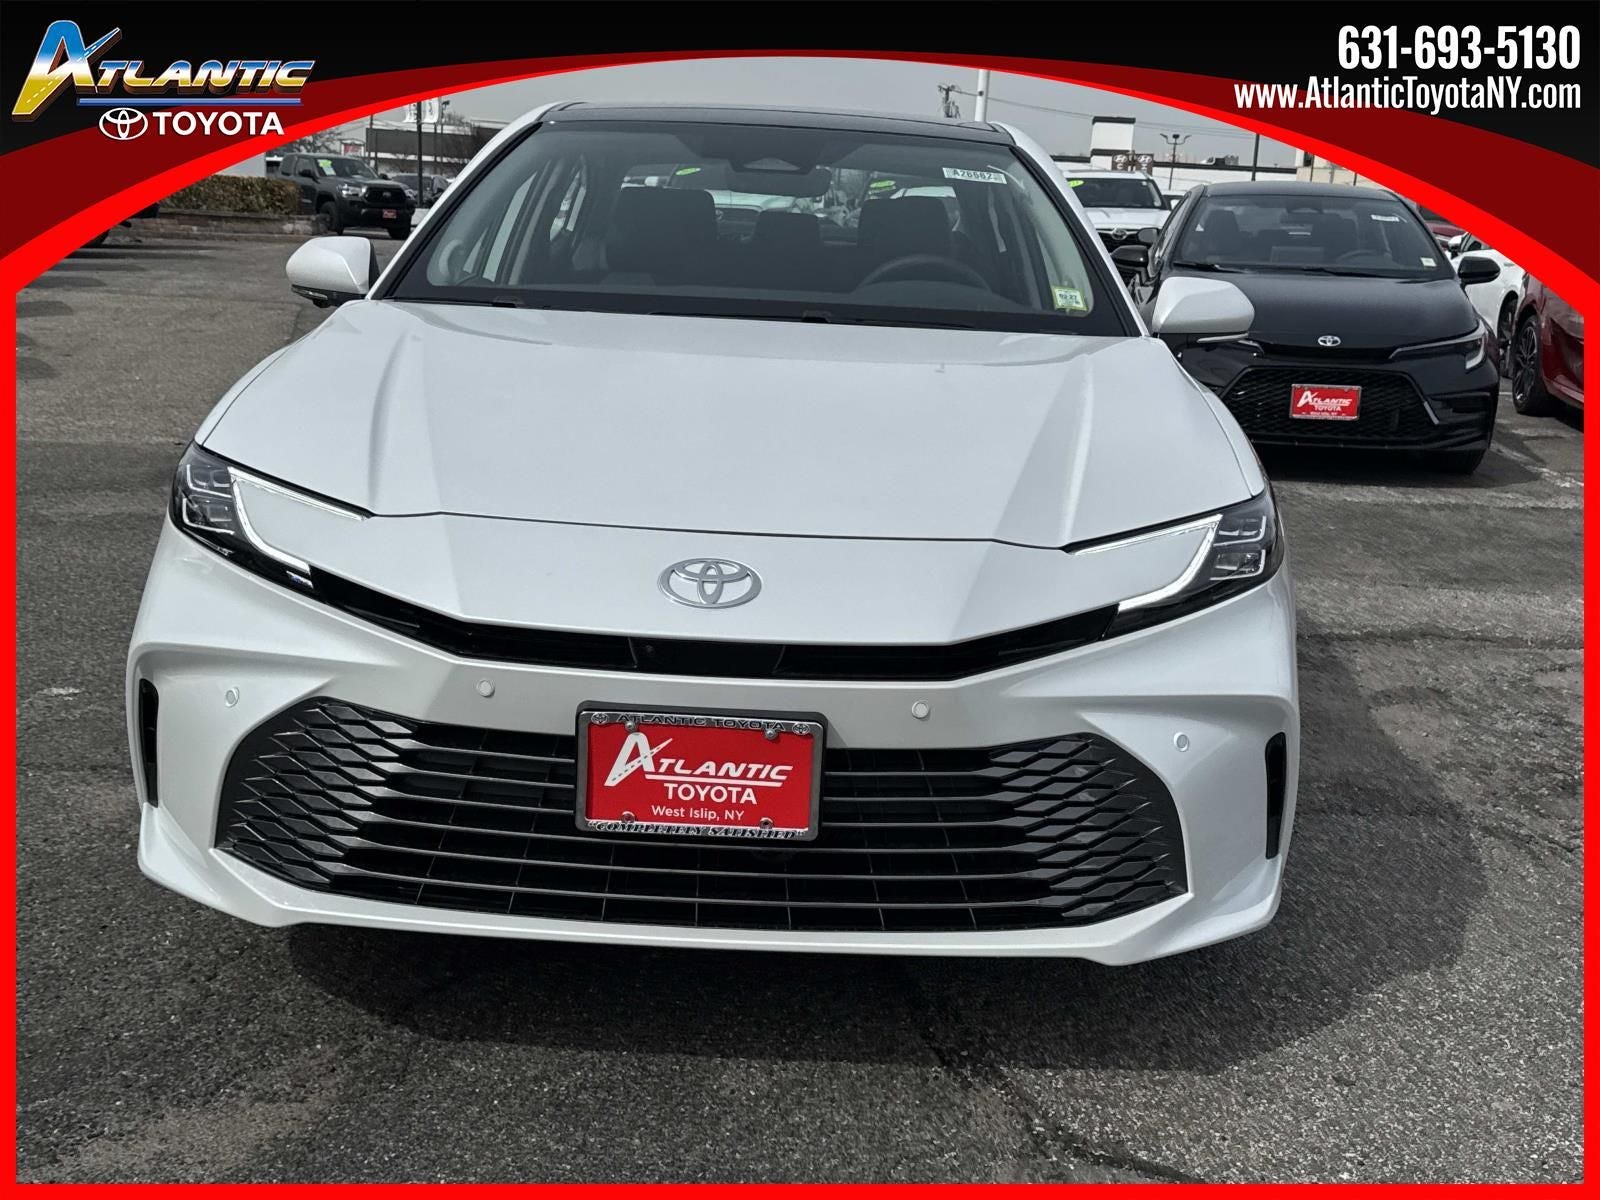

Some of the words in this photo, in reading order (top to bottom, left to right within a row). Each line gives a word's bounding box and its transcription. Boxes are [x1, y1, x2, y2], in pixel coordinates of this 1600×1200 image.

[616, 713, 706, 727] ATLANTIC
[713, 717, 786, 731] TOYOTA
[603, 731, 794, 787] ATLANTIC
[663, 782, 759, 805] TOYOTA
[651, 804, 686, 818] West
[689, 807, 720, 821] Islip,
[724, 809, 745, 821] NY
